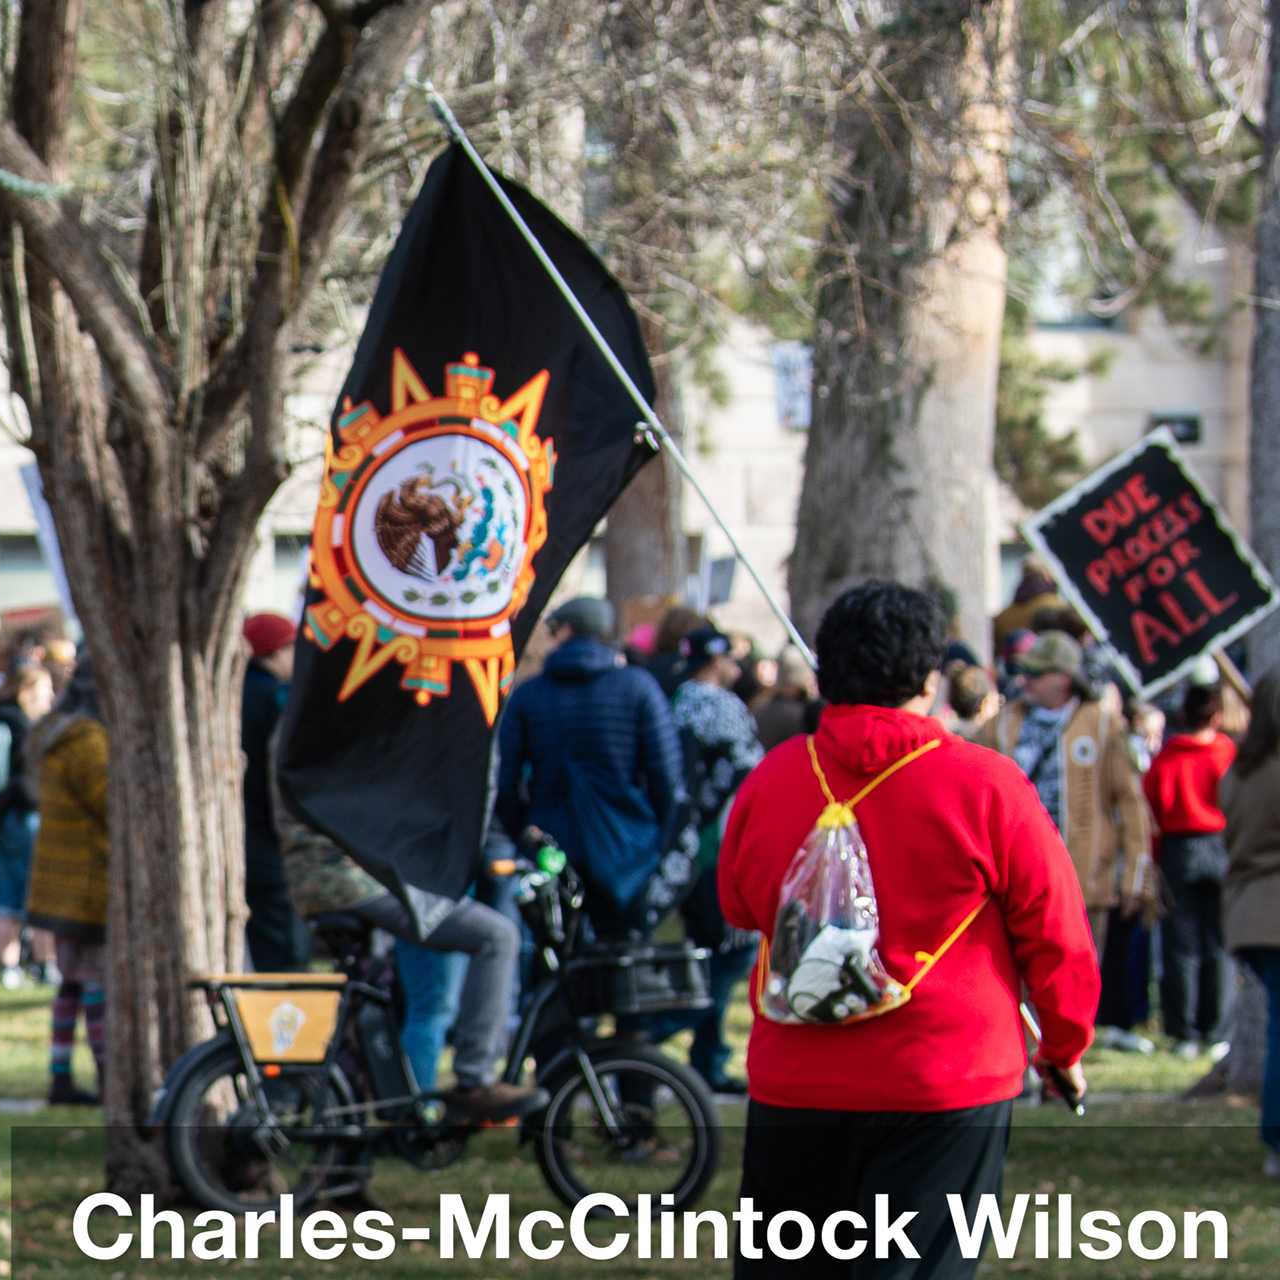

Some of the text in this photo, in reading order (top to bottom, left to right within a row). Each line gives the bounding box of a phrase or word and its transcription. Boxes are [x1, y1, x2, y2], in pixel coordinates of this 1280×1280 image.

[1080, 473, 1161, 546] DUE
[1123, 538, 1201, 604] FOR
[1130, 568, 1239, 665] ALL
